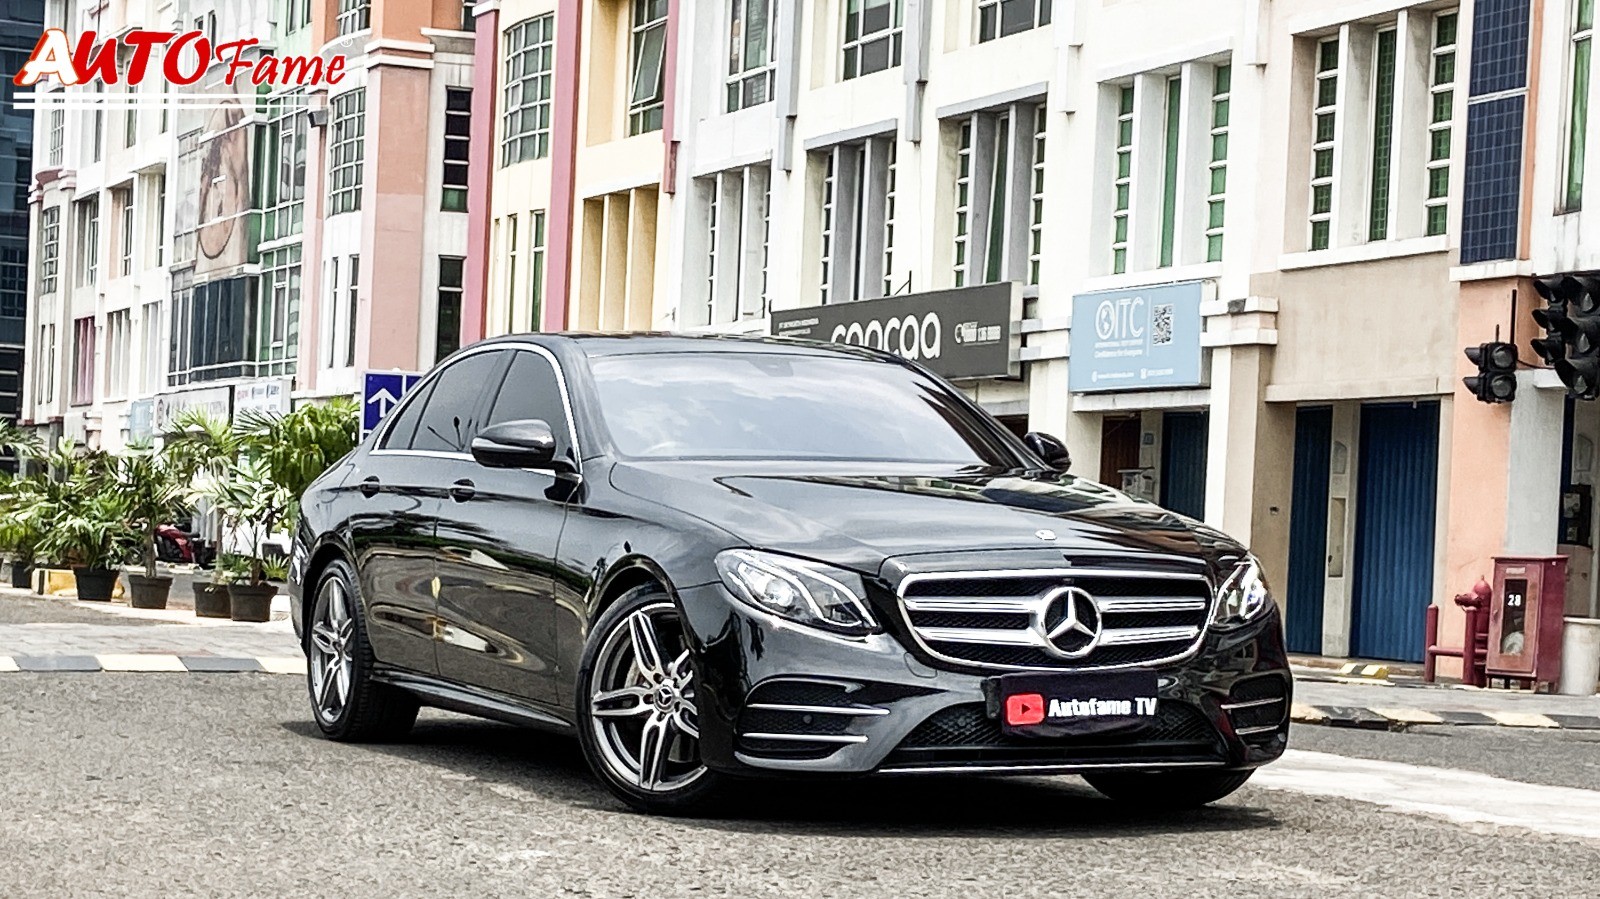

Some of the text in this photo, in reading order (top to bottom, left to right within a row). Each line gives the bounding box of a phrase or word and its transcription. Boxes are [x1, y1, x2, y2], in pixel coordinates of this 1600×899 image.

[1507, 594, 1522, 607] 28
[1048, 697, 1157, 717] Autofame TV
